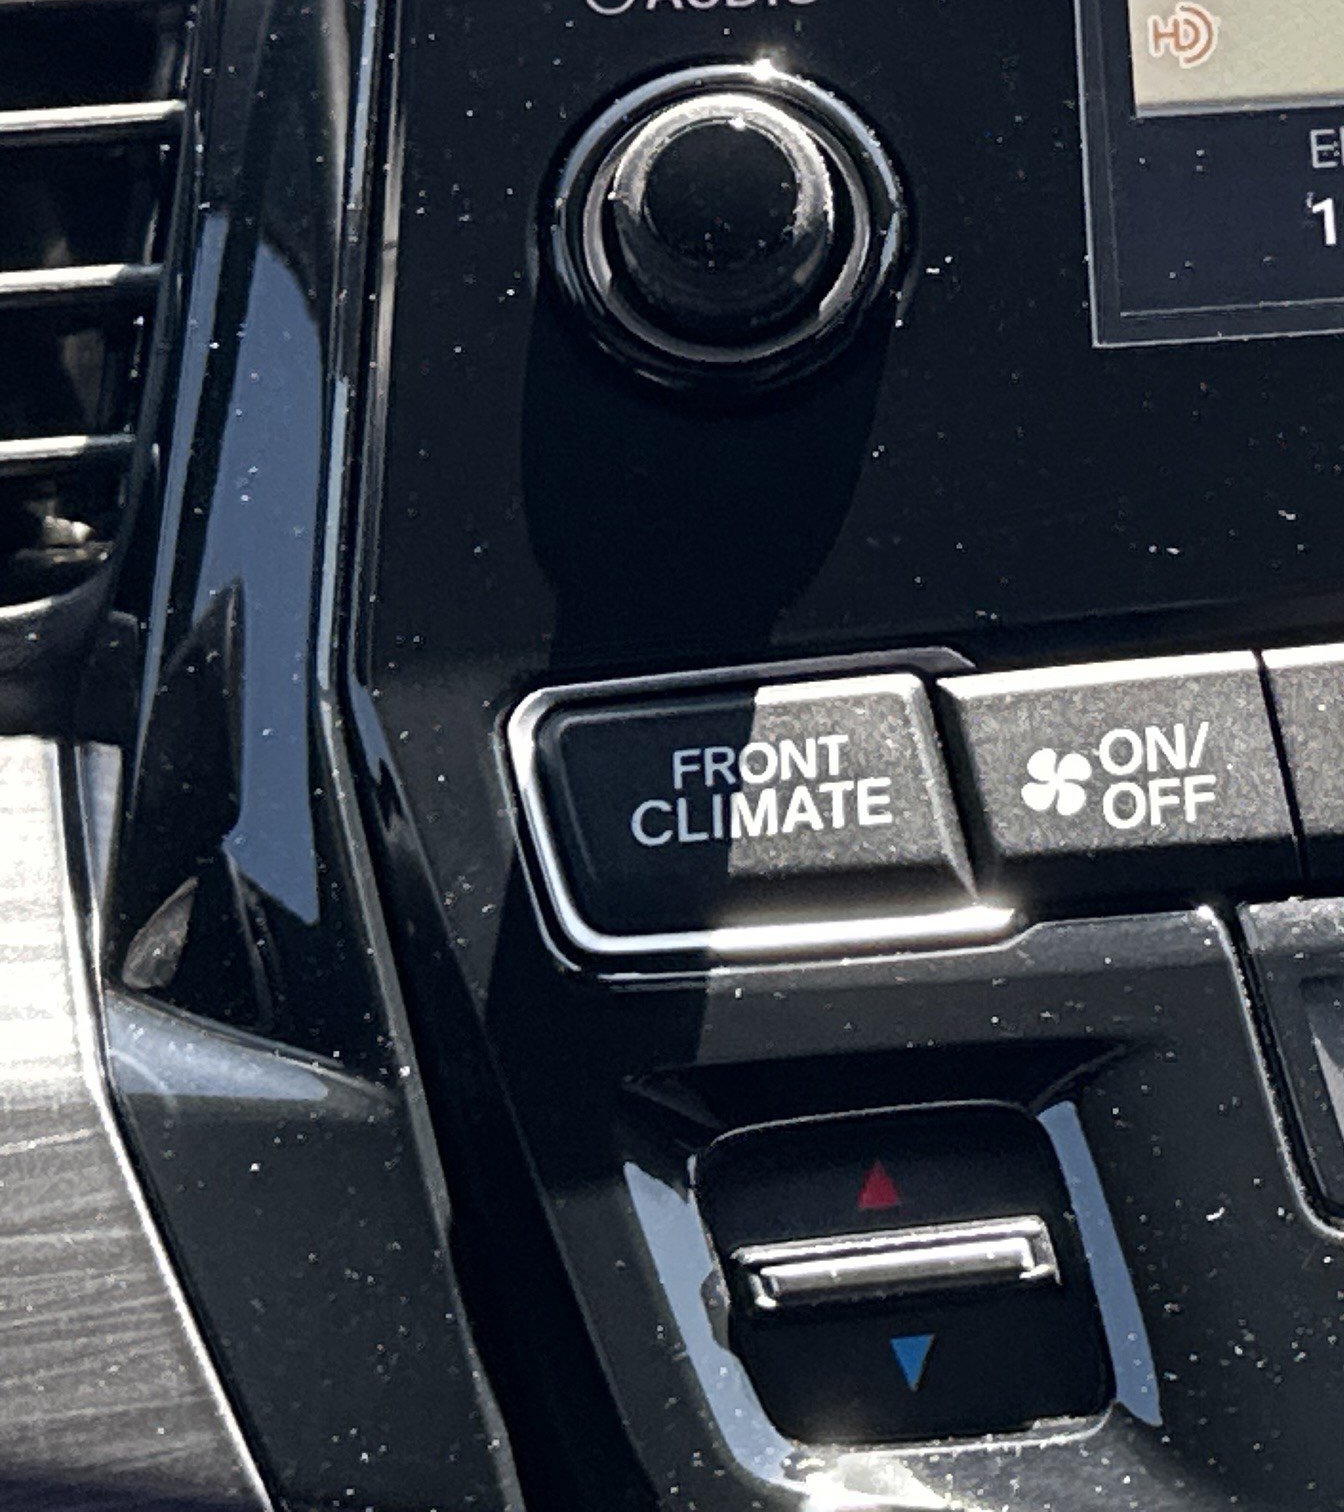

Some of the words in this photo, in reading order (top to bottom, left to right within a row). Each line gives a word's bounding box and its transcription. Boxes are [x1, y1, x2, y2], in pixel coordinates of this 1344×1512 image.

[671, 734, 850, 790] FRONT
[1098, 721, 1210, 776] ON/
[630, 776, 894, 848] CLIMATE
[1102, 774, 1218, 831] OFF
